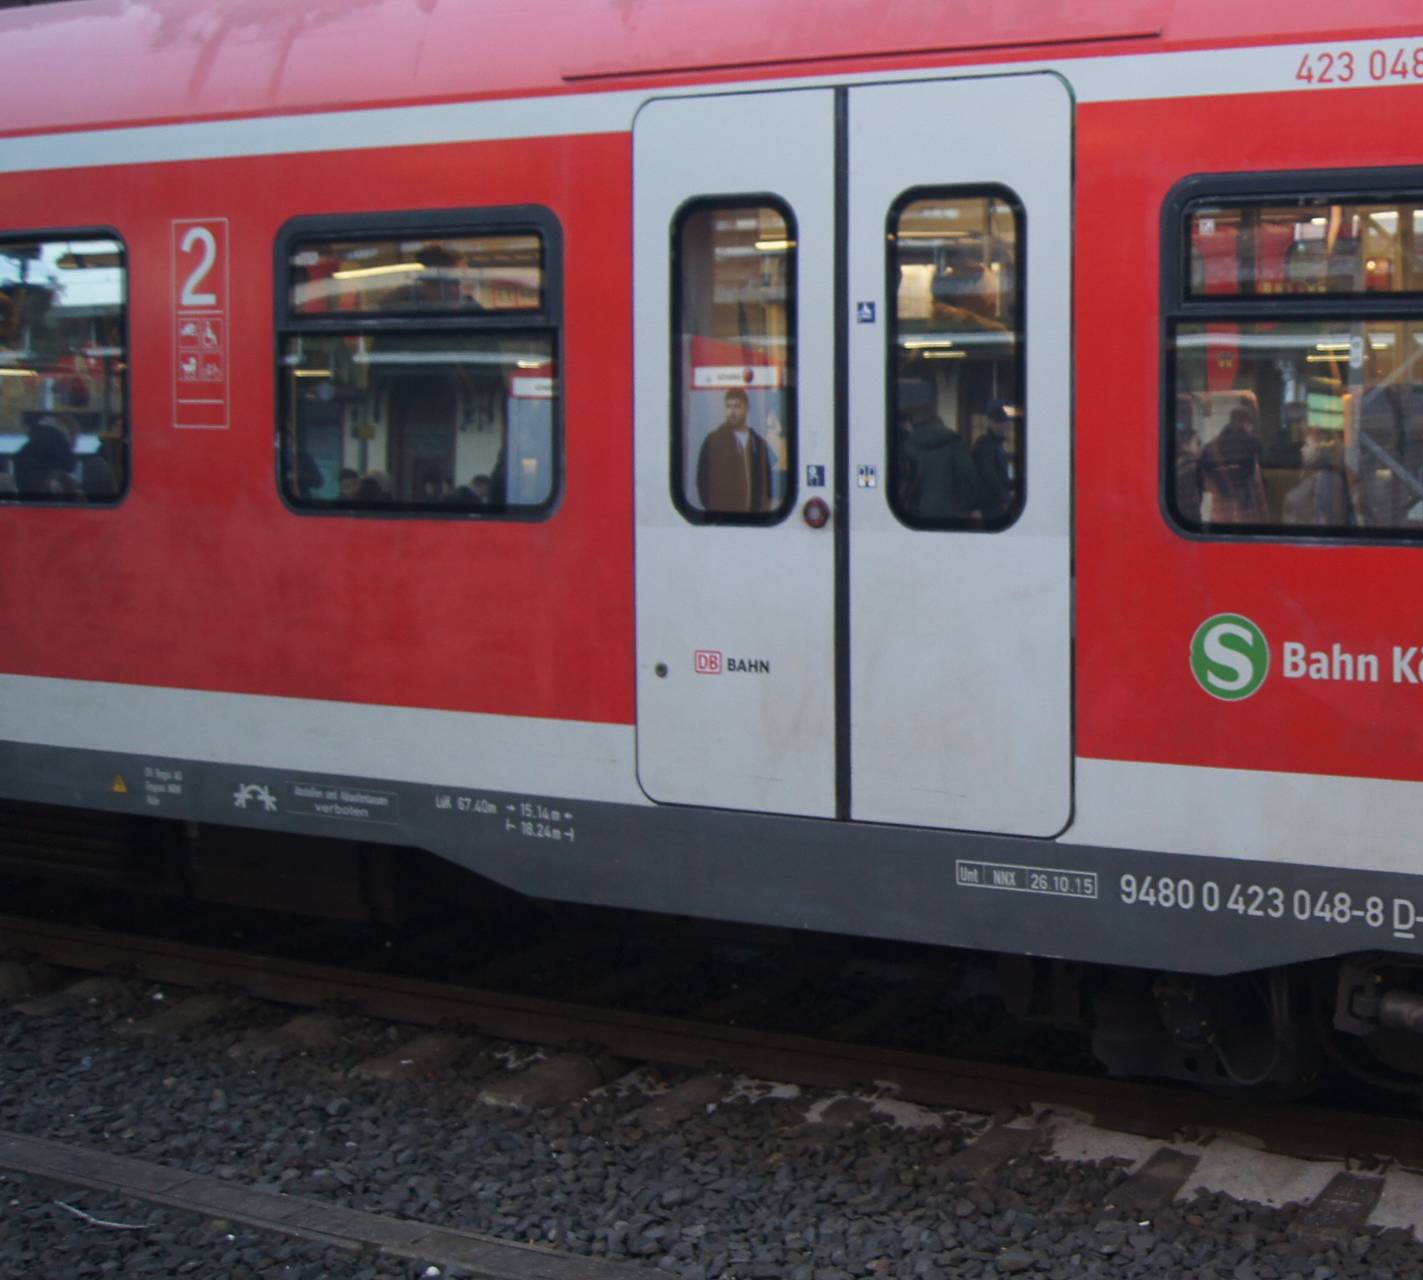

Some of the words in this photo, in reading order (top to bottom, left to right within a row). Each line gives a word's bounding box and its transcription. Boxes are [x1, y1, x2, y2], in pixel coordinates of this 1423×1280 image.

[1295, 51, 1354, 84] 423
[180, 227, 217, 306] 2
[696, 652, 720, 673] DB
[727, 657, 770, 674] BAHN
[1203, 622, 1254, 691] S
[1283, 640, 1379, 682] Bahn
[314, 803, 369, 817] verboten
[993, 868, 1016, 887] NNX
[1030, 873, 1094, 895] 26.10.15
[1119, 873, 1195, 910] 9480
[1202, 881, 1215, 912] 0
[1226, 884, 1285, 918] 423
[1293, 889, 1385, 928] 048-8
